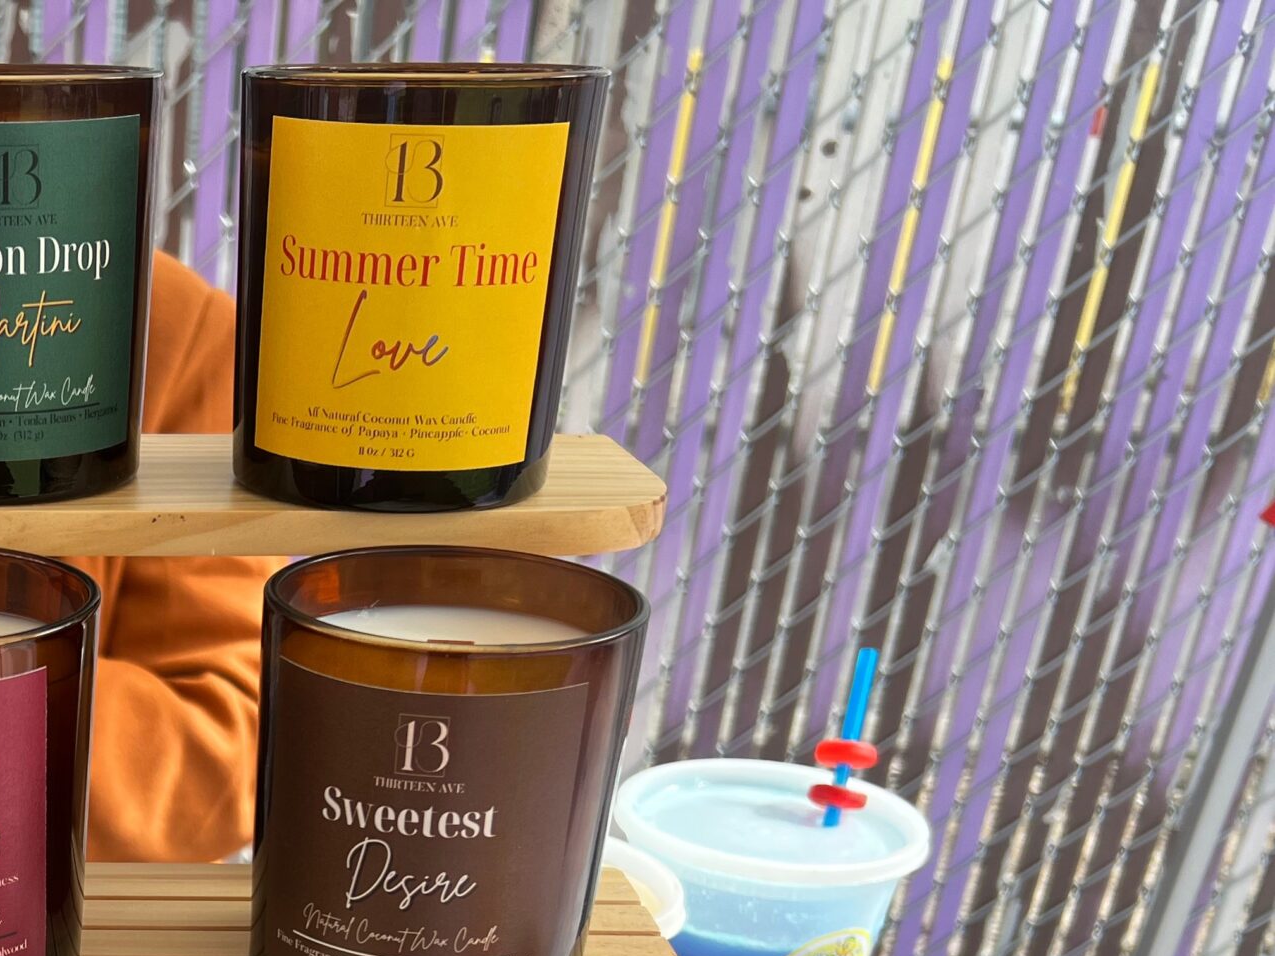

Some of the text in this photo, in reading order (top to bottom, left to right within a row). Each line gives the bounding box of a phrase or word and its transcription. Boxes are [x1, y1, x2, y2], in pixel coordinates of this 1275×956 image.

[35, 214, 57, 225] AVE
[361, 213, 459, 227] THIRTEEN AVE
[37, 236, 110, 280] Drop
[280, 234, 537, 286] Summer Time
[332, 290, 449, 388] Love
[25, 381, 56, 408] Wax
[61, 374, 96, 406] Candle
[17, 416, 46, 427] Tonka
[272, 412, 510, 442] Fine Fragrance of Papaya Pineapple Coconut
[308, 407, 477, 425] All Natural Coconut Wax Candle
[367, 447, 378, 456] Oz
[400, 720, 450, 772] 13
[373, 775, 465, 794] THIRTEEN AVE
[321, 785, 499, 839] Sweetest
[345, 836, 477, 910] Desire
[277, 928, 294, 947] Fine
[303, 902, 499, 953] Natural Coconut Wax Candle
